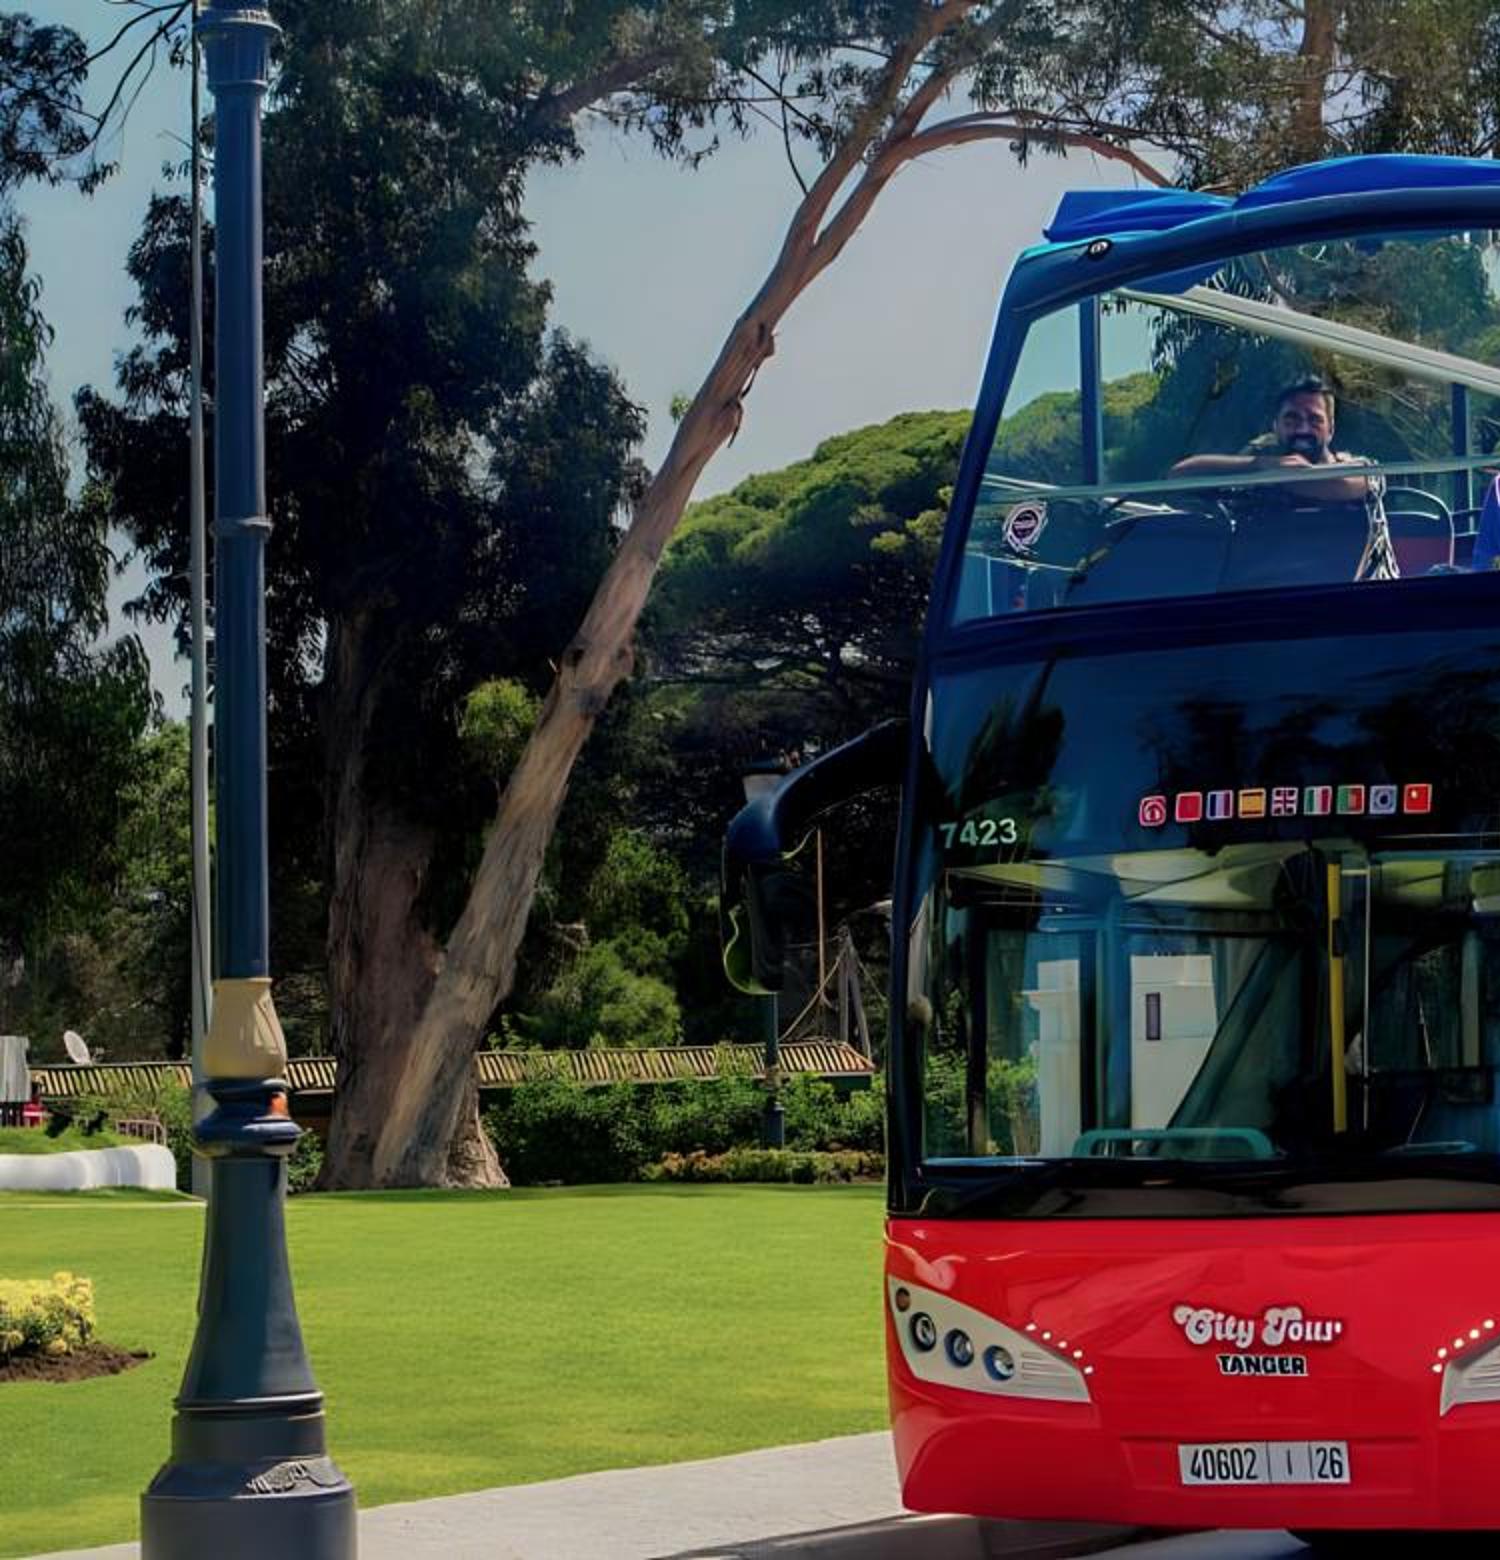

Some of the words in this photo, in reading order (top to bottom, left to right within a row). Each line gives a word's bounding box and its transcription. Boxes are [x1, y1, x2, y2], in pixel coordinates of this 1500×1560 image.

[939, 818, 1017, 849] 7423
[1173, 1305, 1255, 1348] City
[1262, 1306, 1342, 1346] Tour
[1217, 1355, 1306, 1376] TANGER
[1191, 1448, 1258, 1480] 40602
[1316, 1447, 1343, 1479] 26
